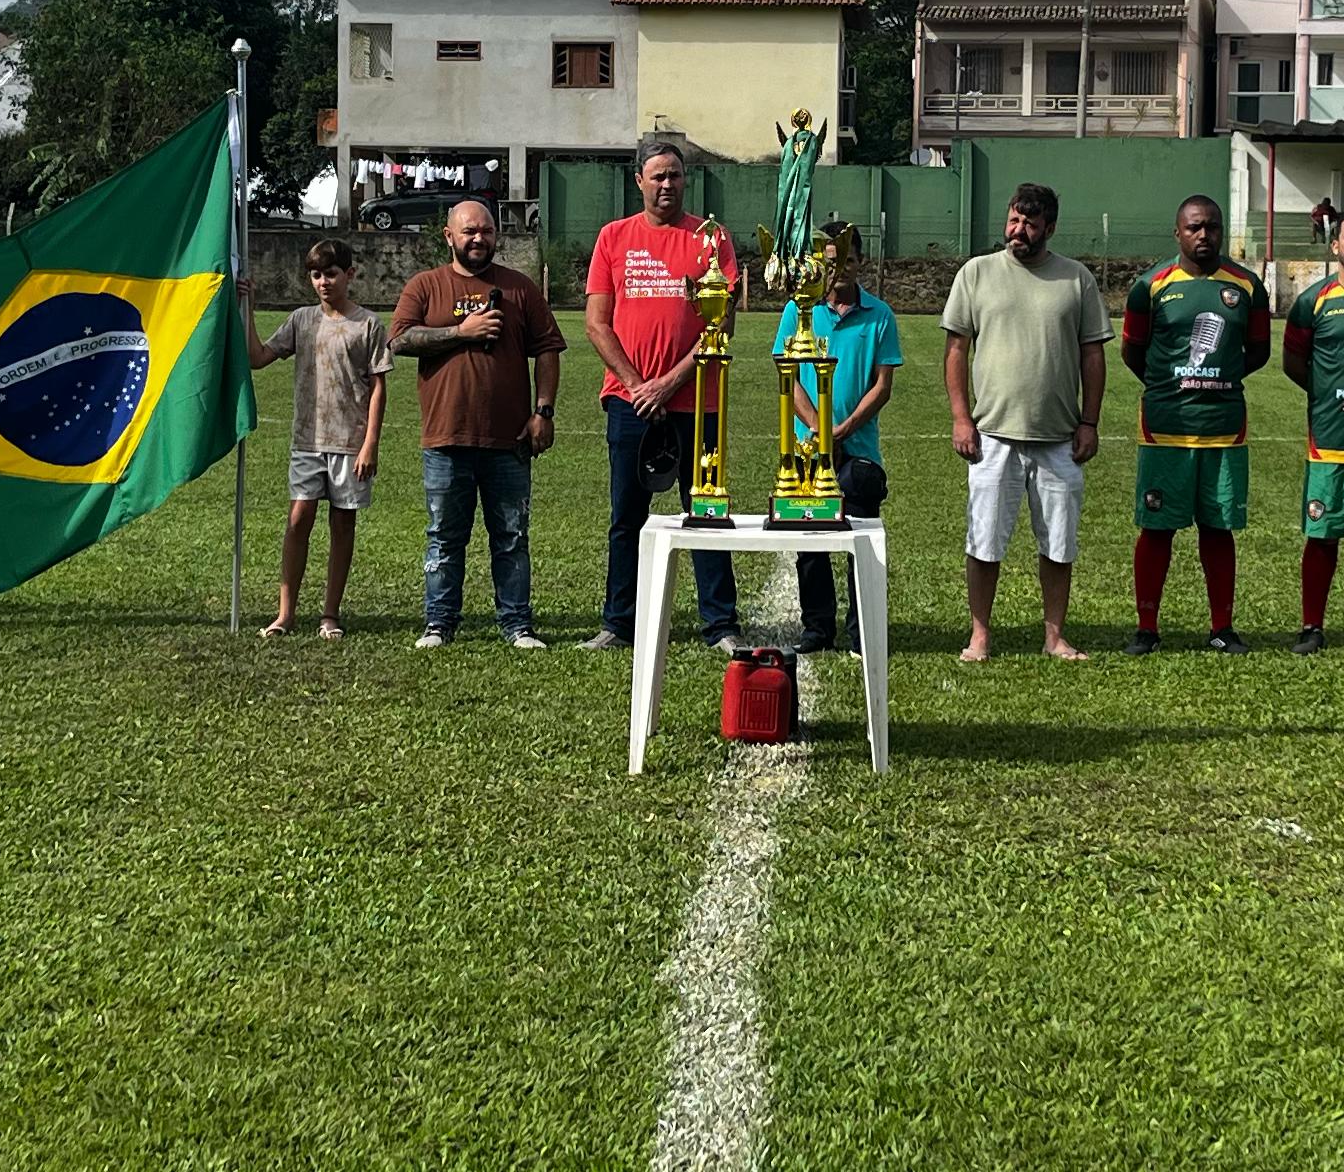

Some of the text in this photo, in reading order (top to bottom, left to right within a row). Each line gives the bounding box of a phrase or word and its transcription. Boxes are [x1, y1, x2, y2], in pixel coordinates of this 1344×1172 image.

[626, 249, 651, 258] Café,
[625, 258, 666, 268] Queijos,
[624, 268, 671, 278] Cervejas,
[0, 357, 47, 385] ORDEM
[70, 335, 147, 357] PROGRESSO
[1174, 366, 1221, 377] PODCAST
